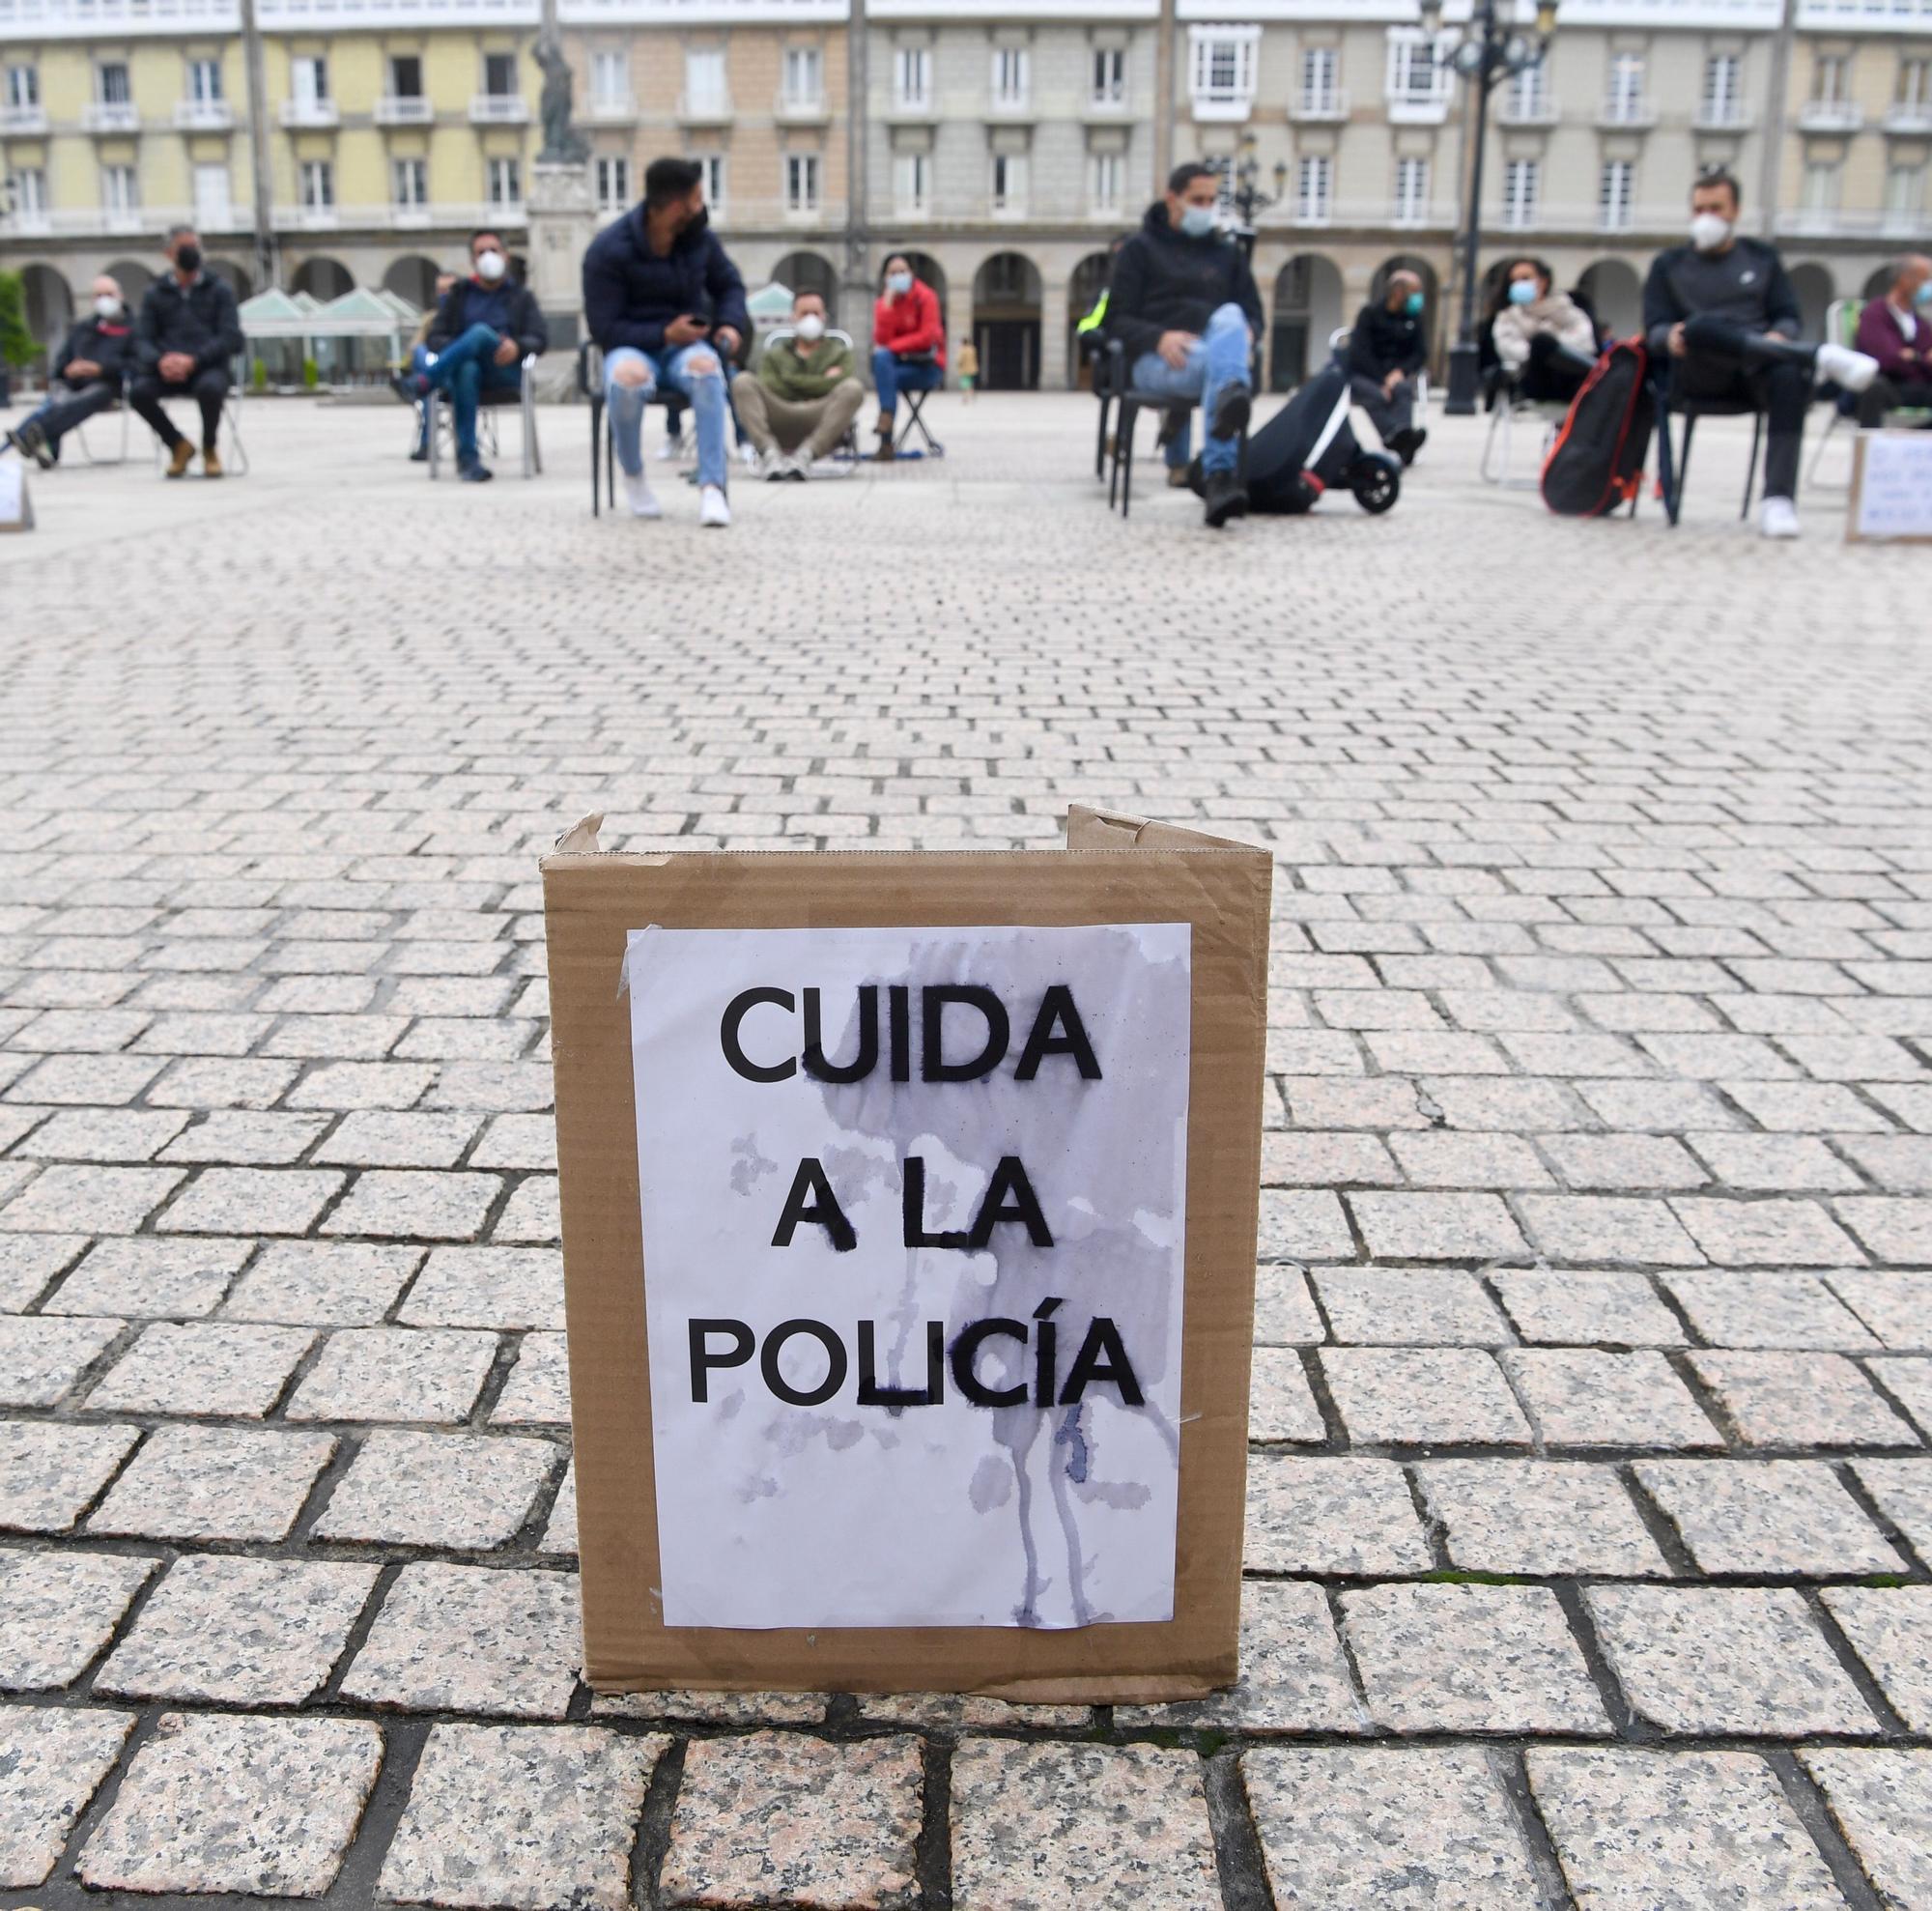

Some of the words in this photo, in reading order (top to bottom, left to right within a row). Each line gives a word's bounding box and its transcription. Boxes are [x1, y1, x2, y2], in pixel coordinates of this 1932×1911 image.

[720, 984, 1102, 1083] CUIDA
[771, 1157, 857, 1251] A
[902, 1156, 1054, 1249] LA
[688, 1298, 1146, 1409] POLICÍA
